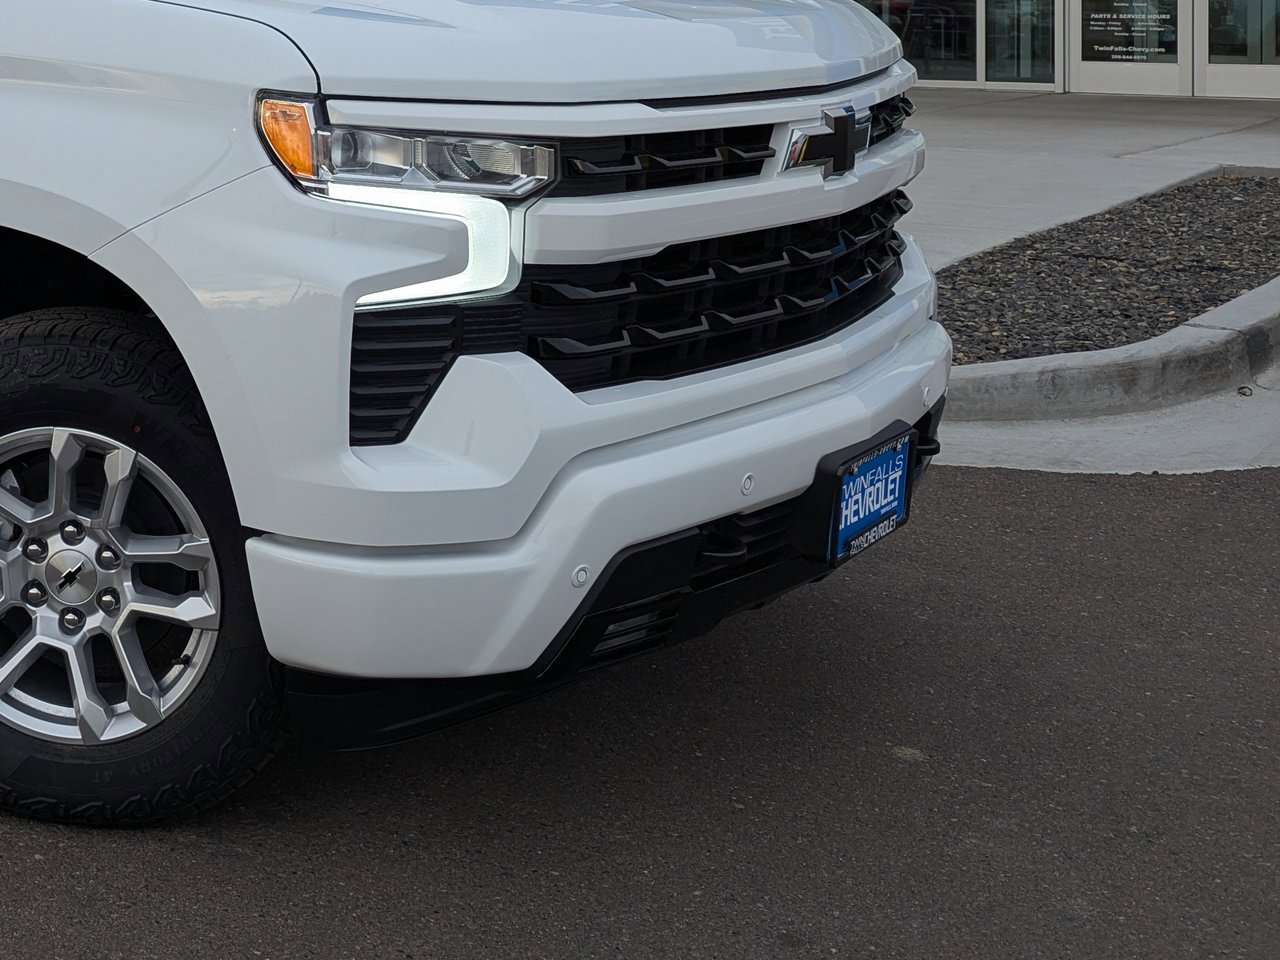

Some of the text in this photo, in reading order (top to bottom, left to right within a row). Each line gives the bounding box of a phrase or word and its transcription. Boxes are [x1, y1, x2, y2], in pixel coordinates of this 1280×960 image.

[839, 469, 902, 530] HEVROLET
[842, 454, 904, 500] WINFALLS
[863, 514, 898, 548] CHEVROLET
